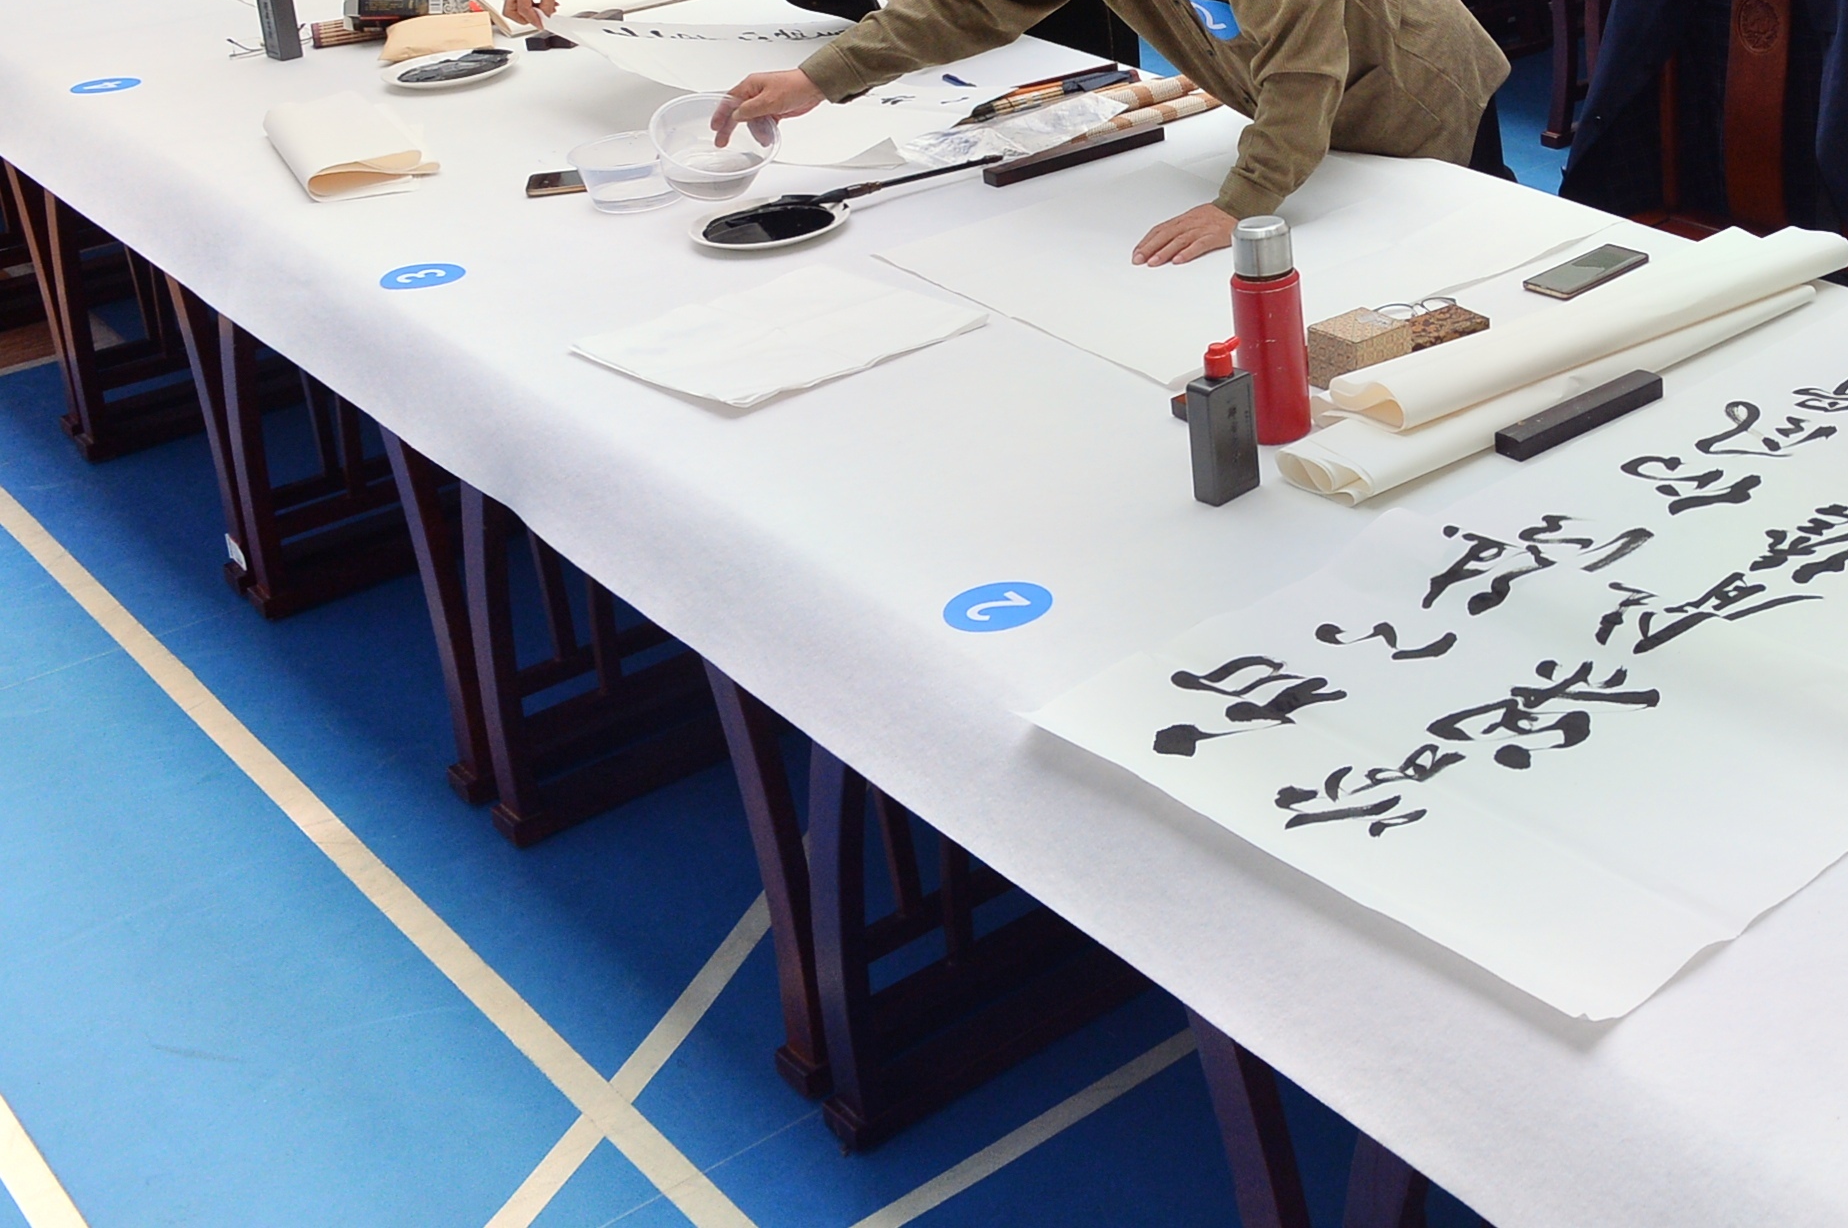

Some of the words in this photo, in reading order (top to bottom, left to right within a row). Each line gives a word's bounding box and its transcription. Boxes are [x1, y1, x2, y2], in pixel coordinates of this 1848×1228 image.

[84, 80, 121, 90] 4
[396, 268, 446, 283] 3
[966, 590, 1031, 620] 2
